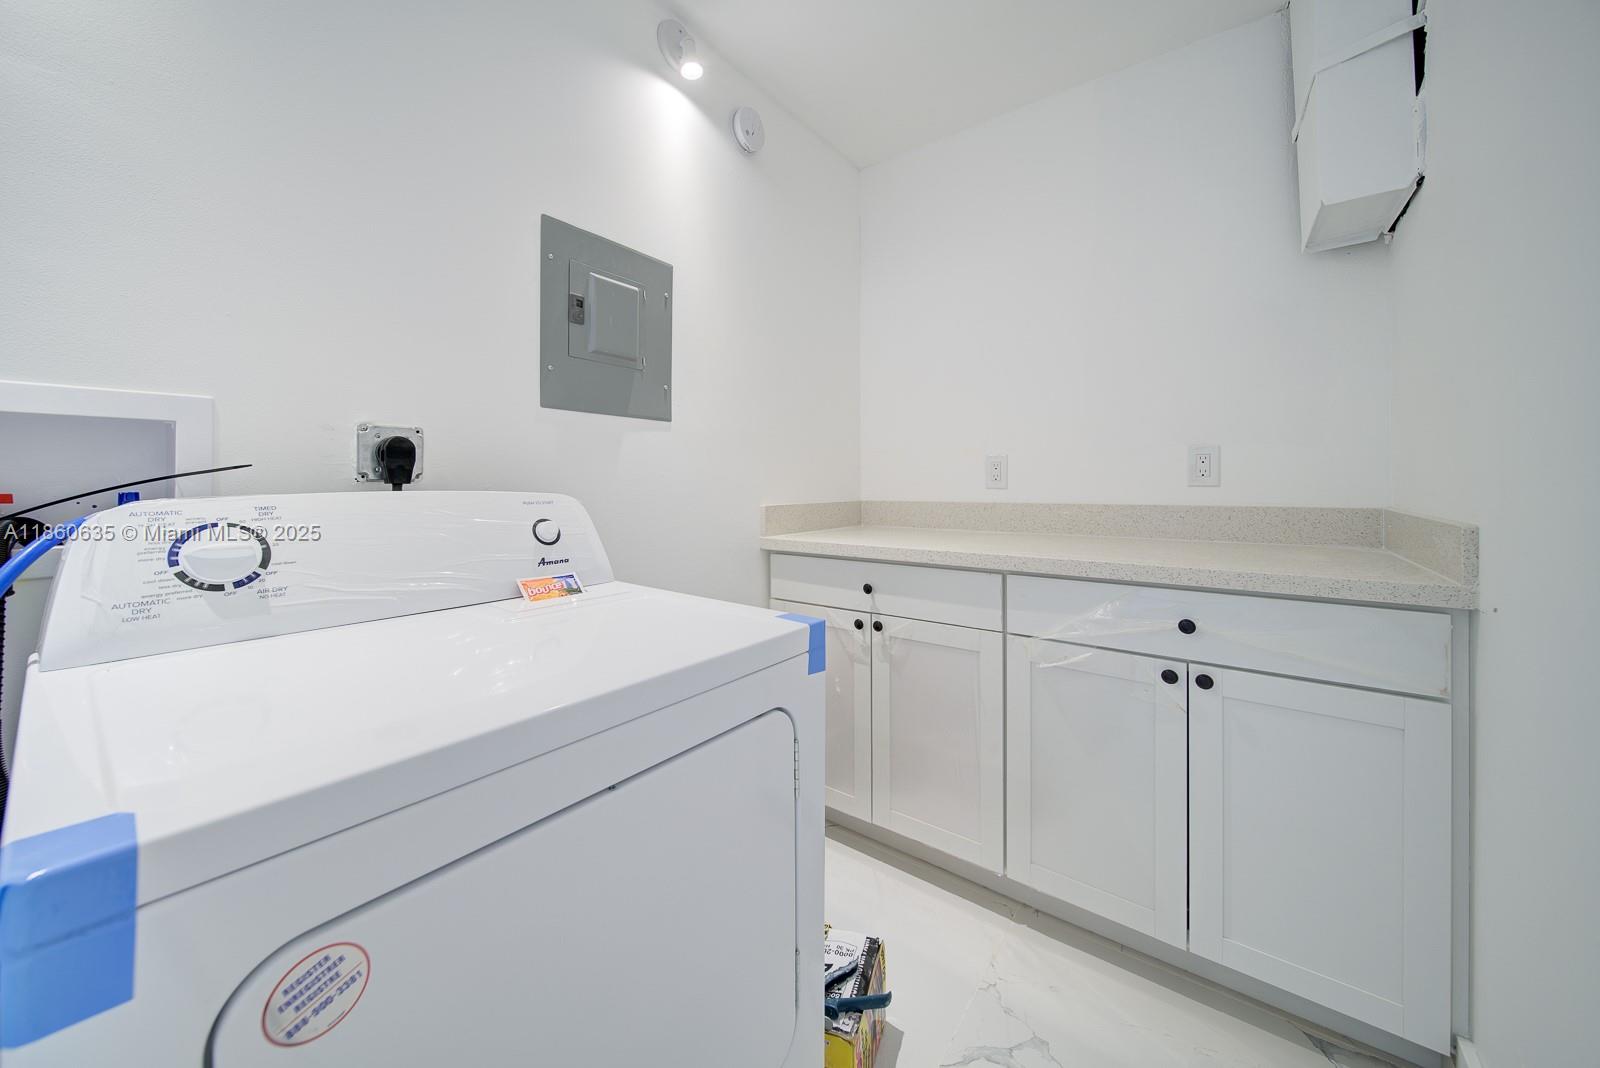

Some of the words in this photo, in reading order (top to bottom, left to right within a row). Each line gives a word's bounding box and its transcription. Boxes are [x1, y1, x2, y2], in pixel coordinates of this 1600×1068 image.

[537, 557, 570, 568] Amana
[111, 598, 171, 610] AUTOMATIC
[131, 607, 152, 616] DRY
[141, 613, 161, 621] HEAT
